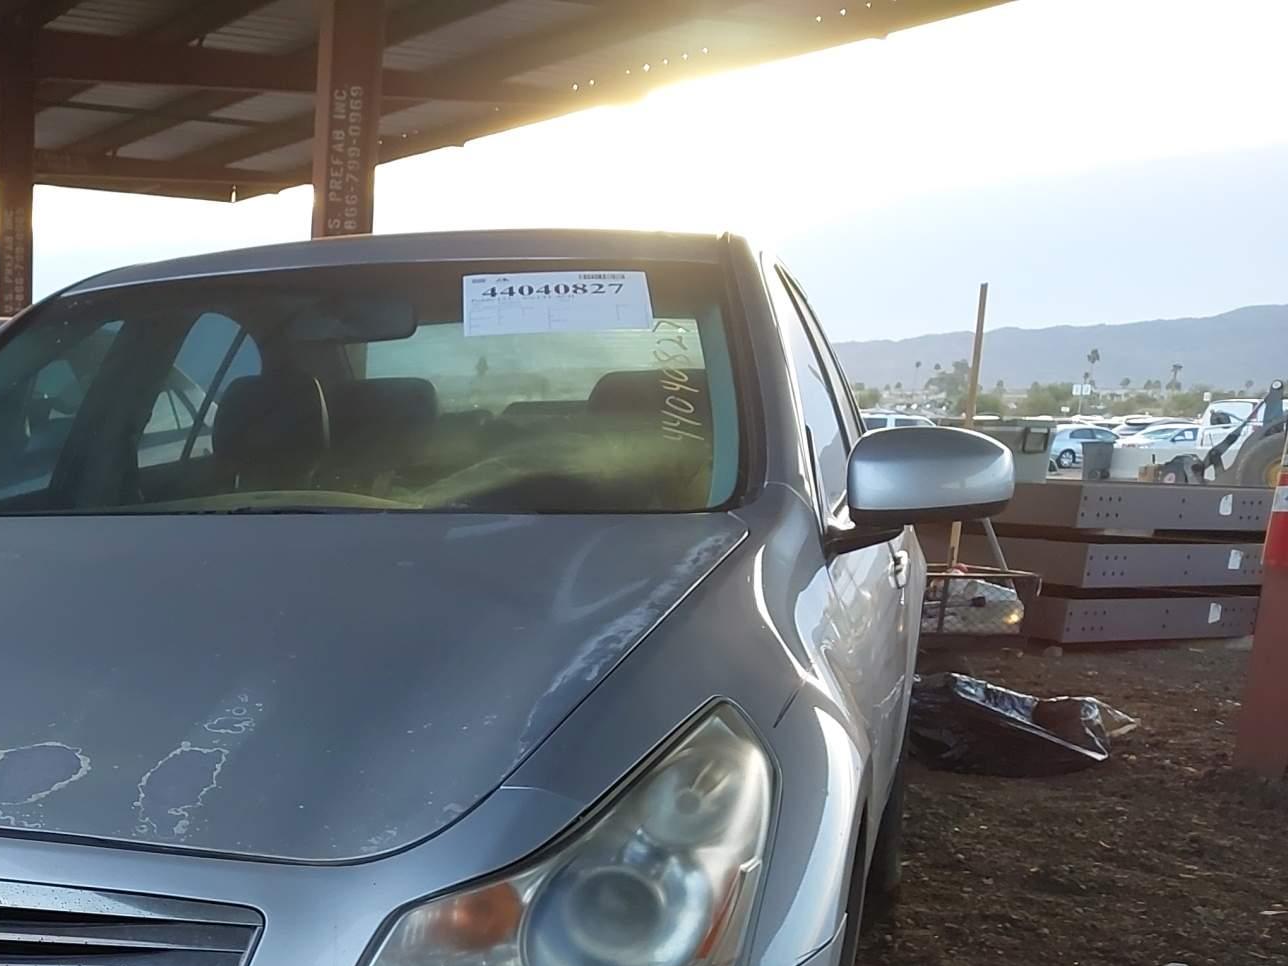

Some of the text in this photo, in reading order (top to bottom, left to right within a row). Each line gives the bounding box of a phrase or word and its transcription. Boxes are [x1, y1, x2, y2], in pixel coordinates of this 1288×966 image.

[328, 129, 345, 202] PREFAB
[481, 282, 625, 298] 44040827
[652, 320, 705, 441] 44040827
